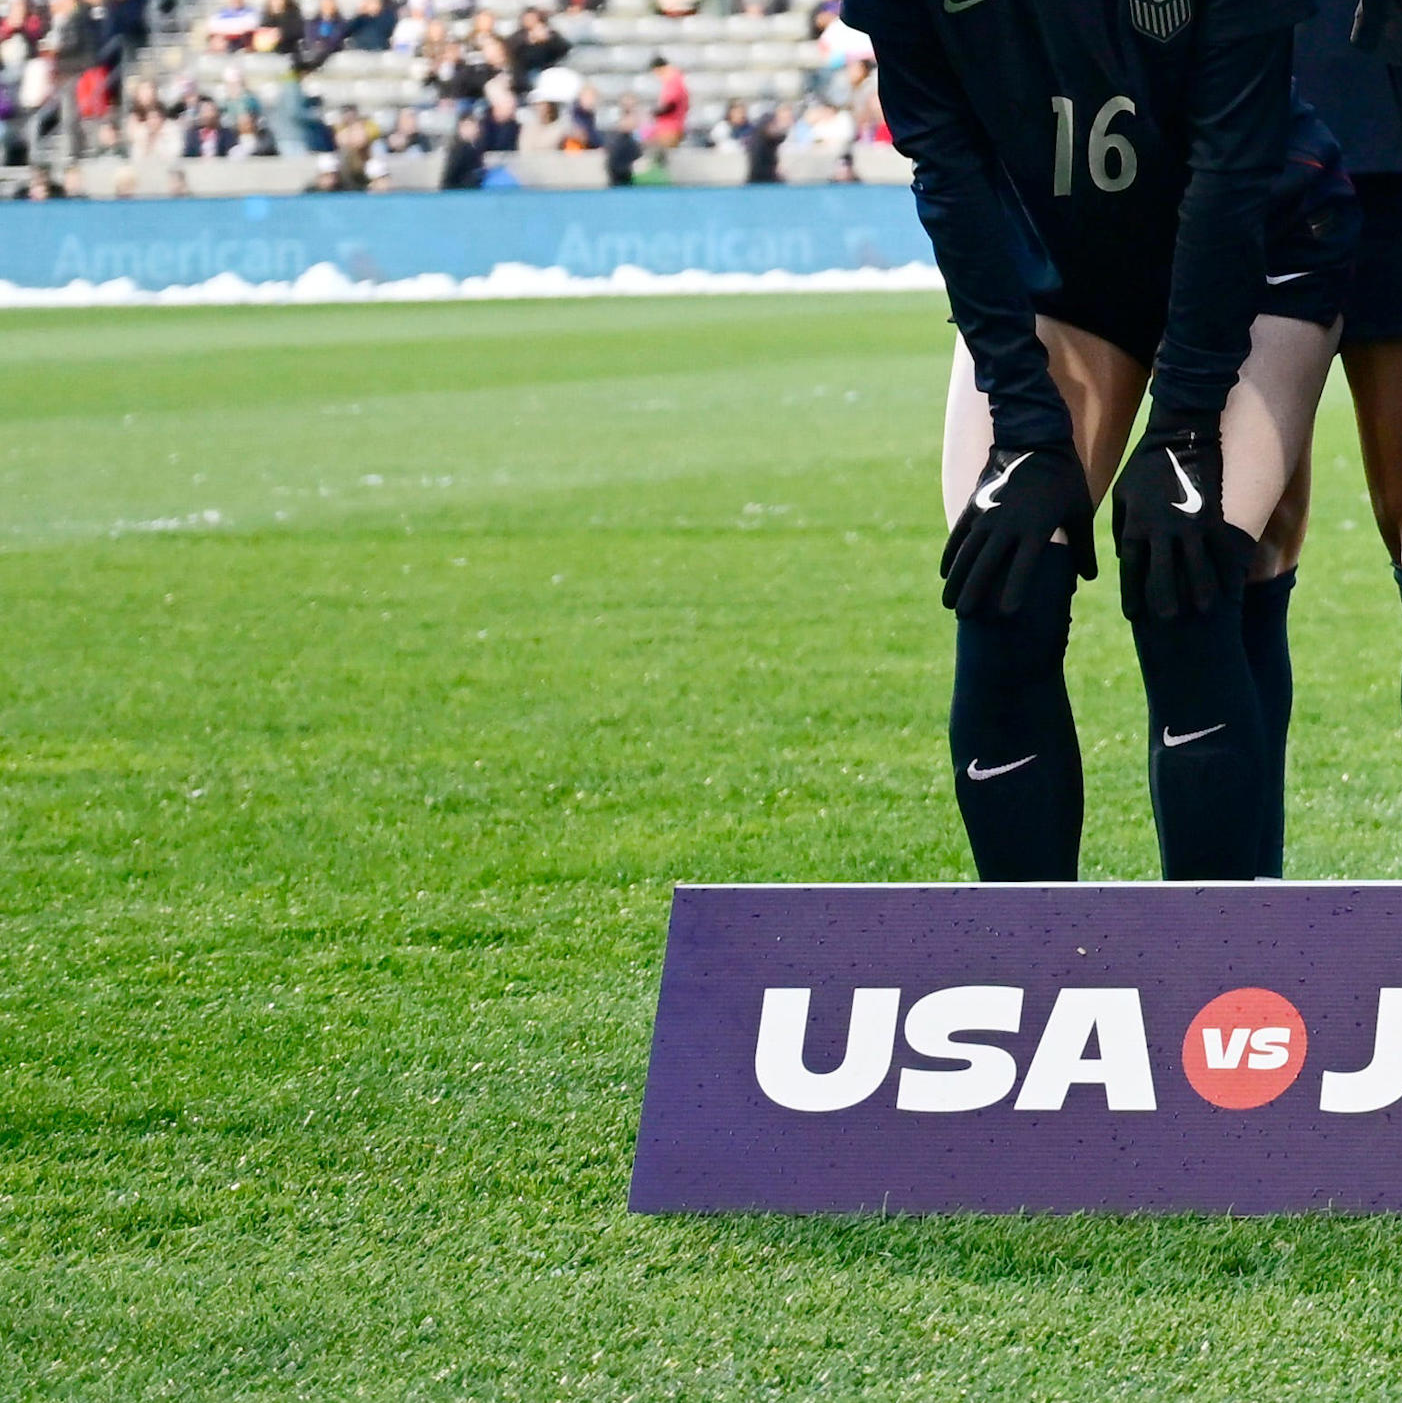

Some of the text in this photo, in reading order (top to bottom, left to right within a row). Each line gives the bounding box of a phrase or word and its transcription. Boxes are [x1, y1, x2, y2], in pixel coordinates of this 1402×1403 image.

[1051, 95, 1138, 197] 16
[52, 229, 307, 278] American
[555, 219, 812, 266] American
[755, 985, 1157, 1113] USA
